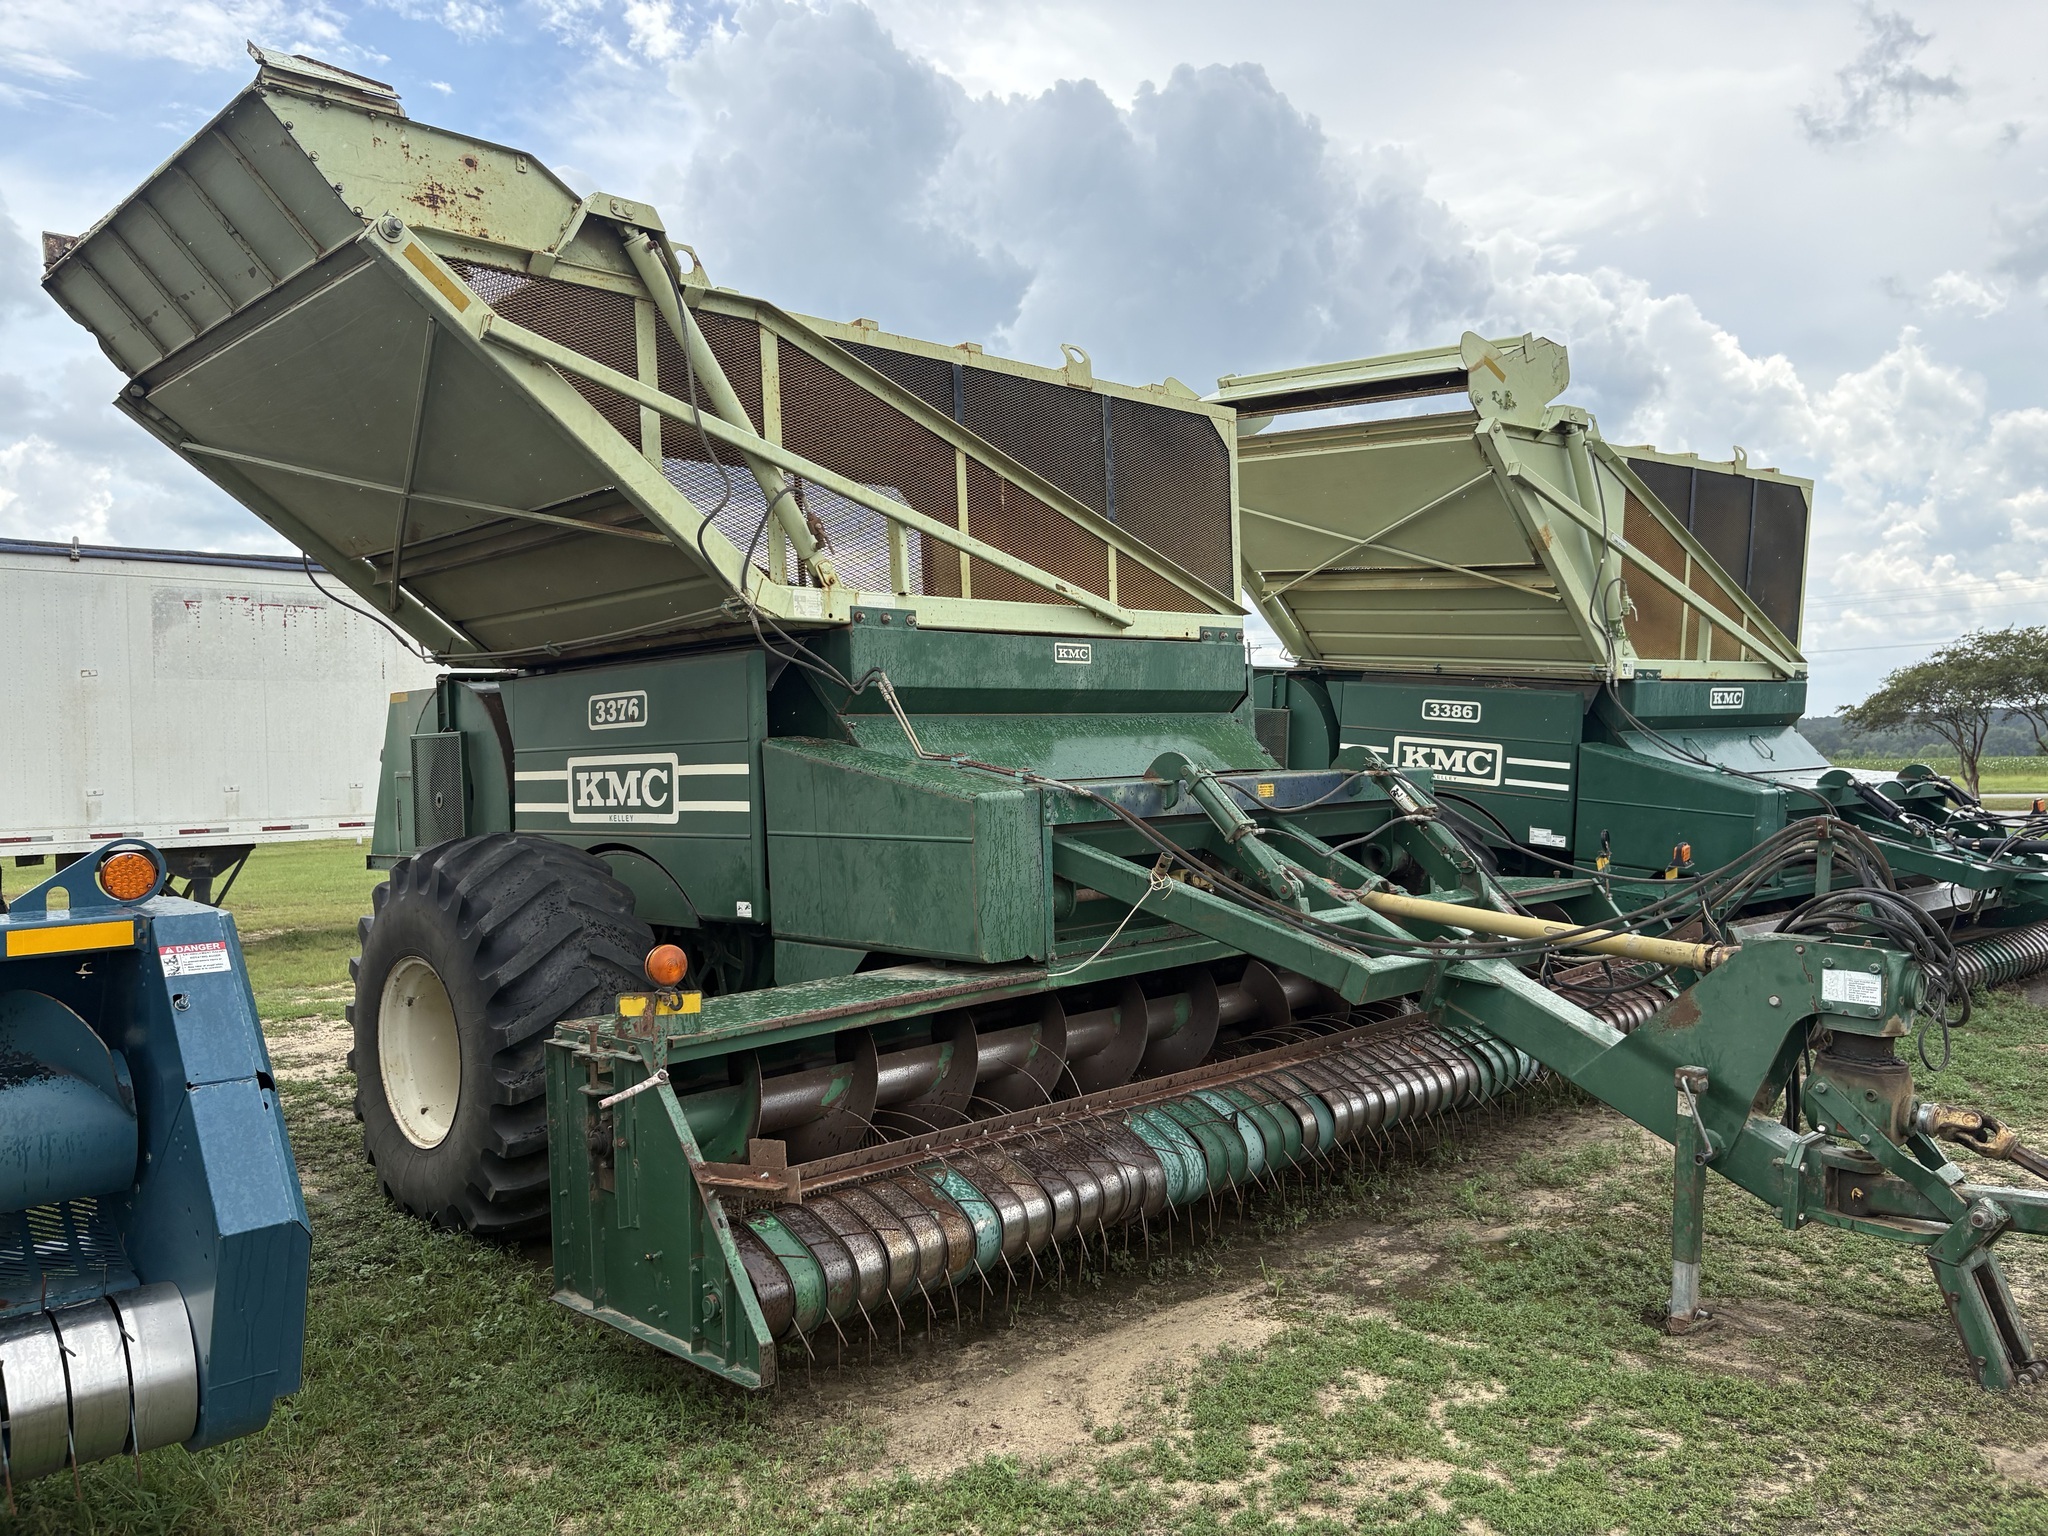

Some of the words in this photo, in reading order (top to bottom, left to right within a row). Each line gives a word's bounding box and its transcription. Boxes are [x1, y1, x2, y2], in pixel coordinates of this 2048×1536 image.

[1058, 648, 1088, 659] KMC
[1713, 692, 1742, 704] KMC
[595, 698, 639, 723] 3376
[1429, 703, 1473, 719] 3386
[1401, 745, 1493, 775] KMC
[576, 768, 668, 807] KMC
[608, 814, 634, 822] KELLEY
[175, 942, 221, 953] DANGER
